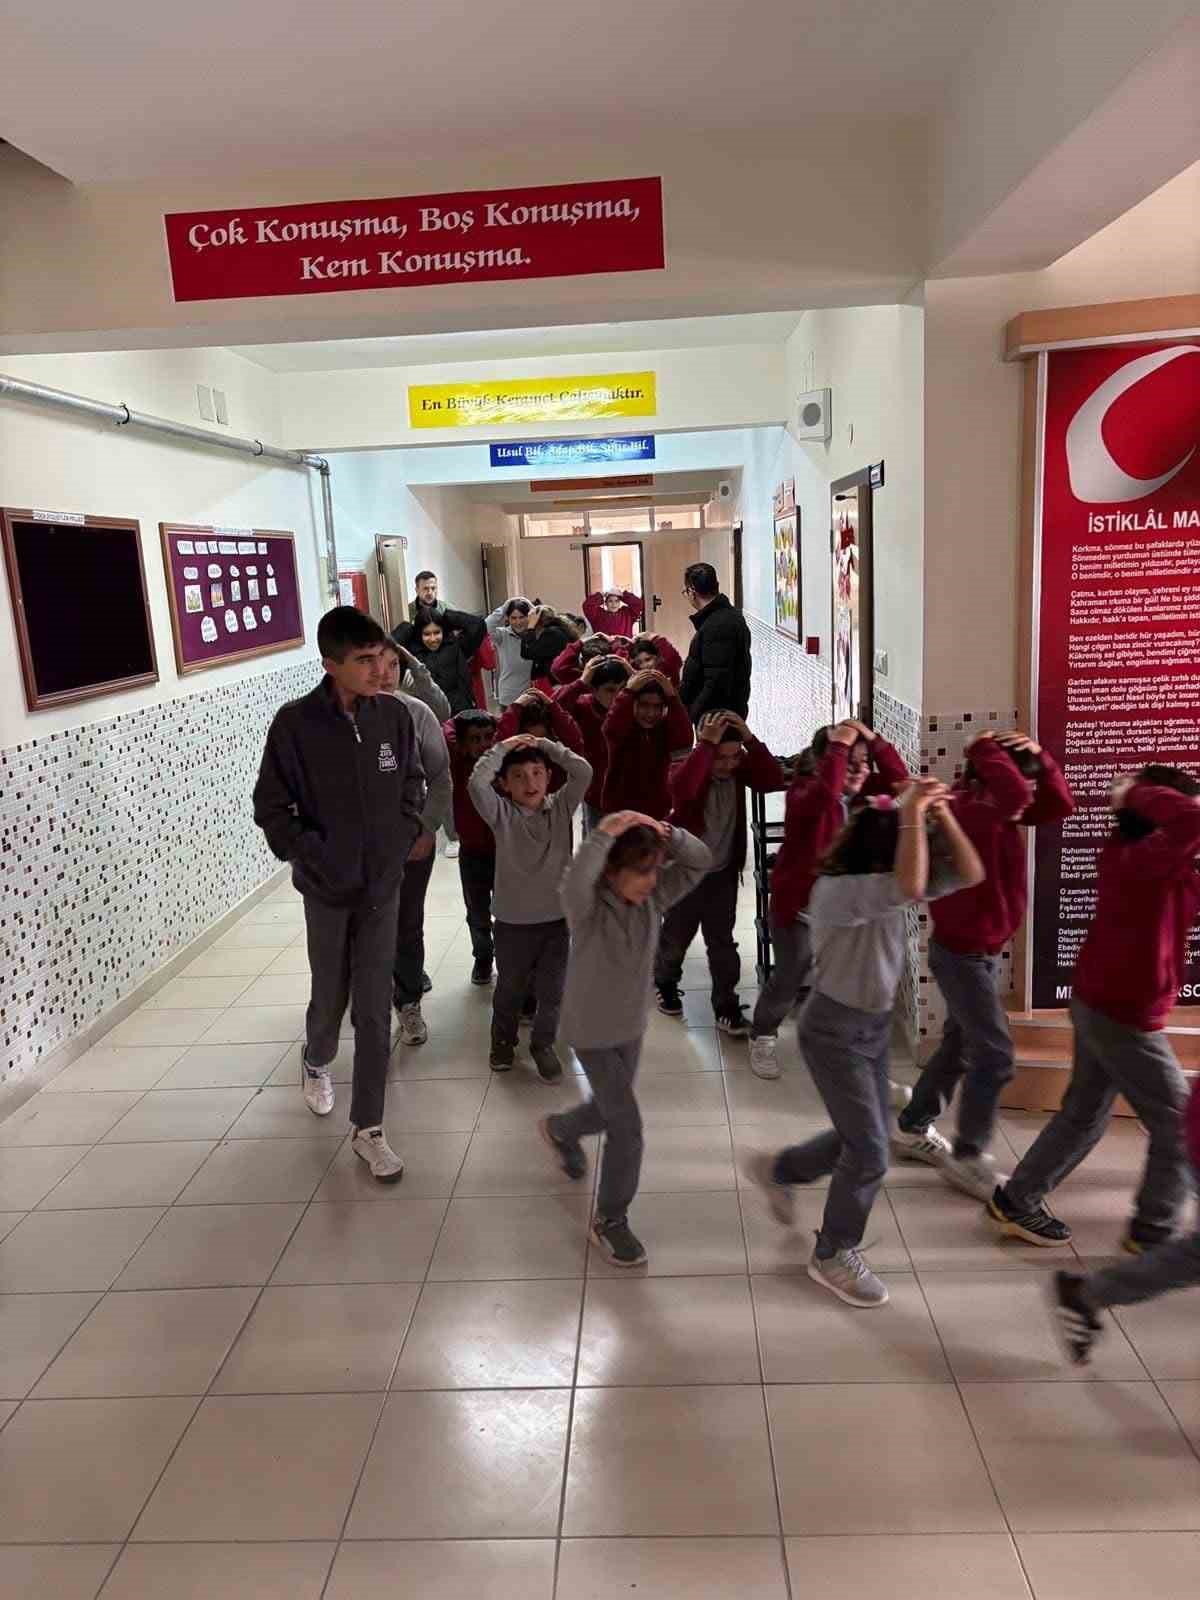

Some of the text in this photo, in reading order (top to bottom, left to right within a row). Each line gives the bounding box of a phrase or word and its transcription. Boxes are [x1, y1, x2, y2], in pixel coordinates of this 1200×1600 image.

[188, 197, 641, 253] Çok Konuşma, Boş Konuşma,
[299, 246, 532, 280] Kem Konuşma.
[421, 398, 442, 411] En
[1088, 508, 1168, 533] İSTİKLÂL
